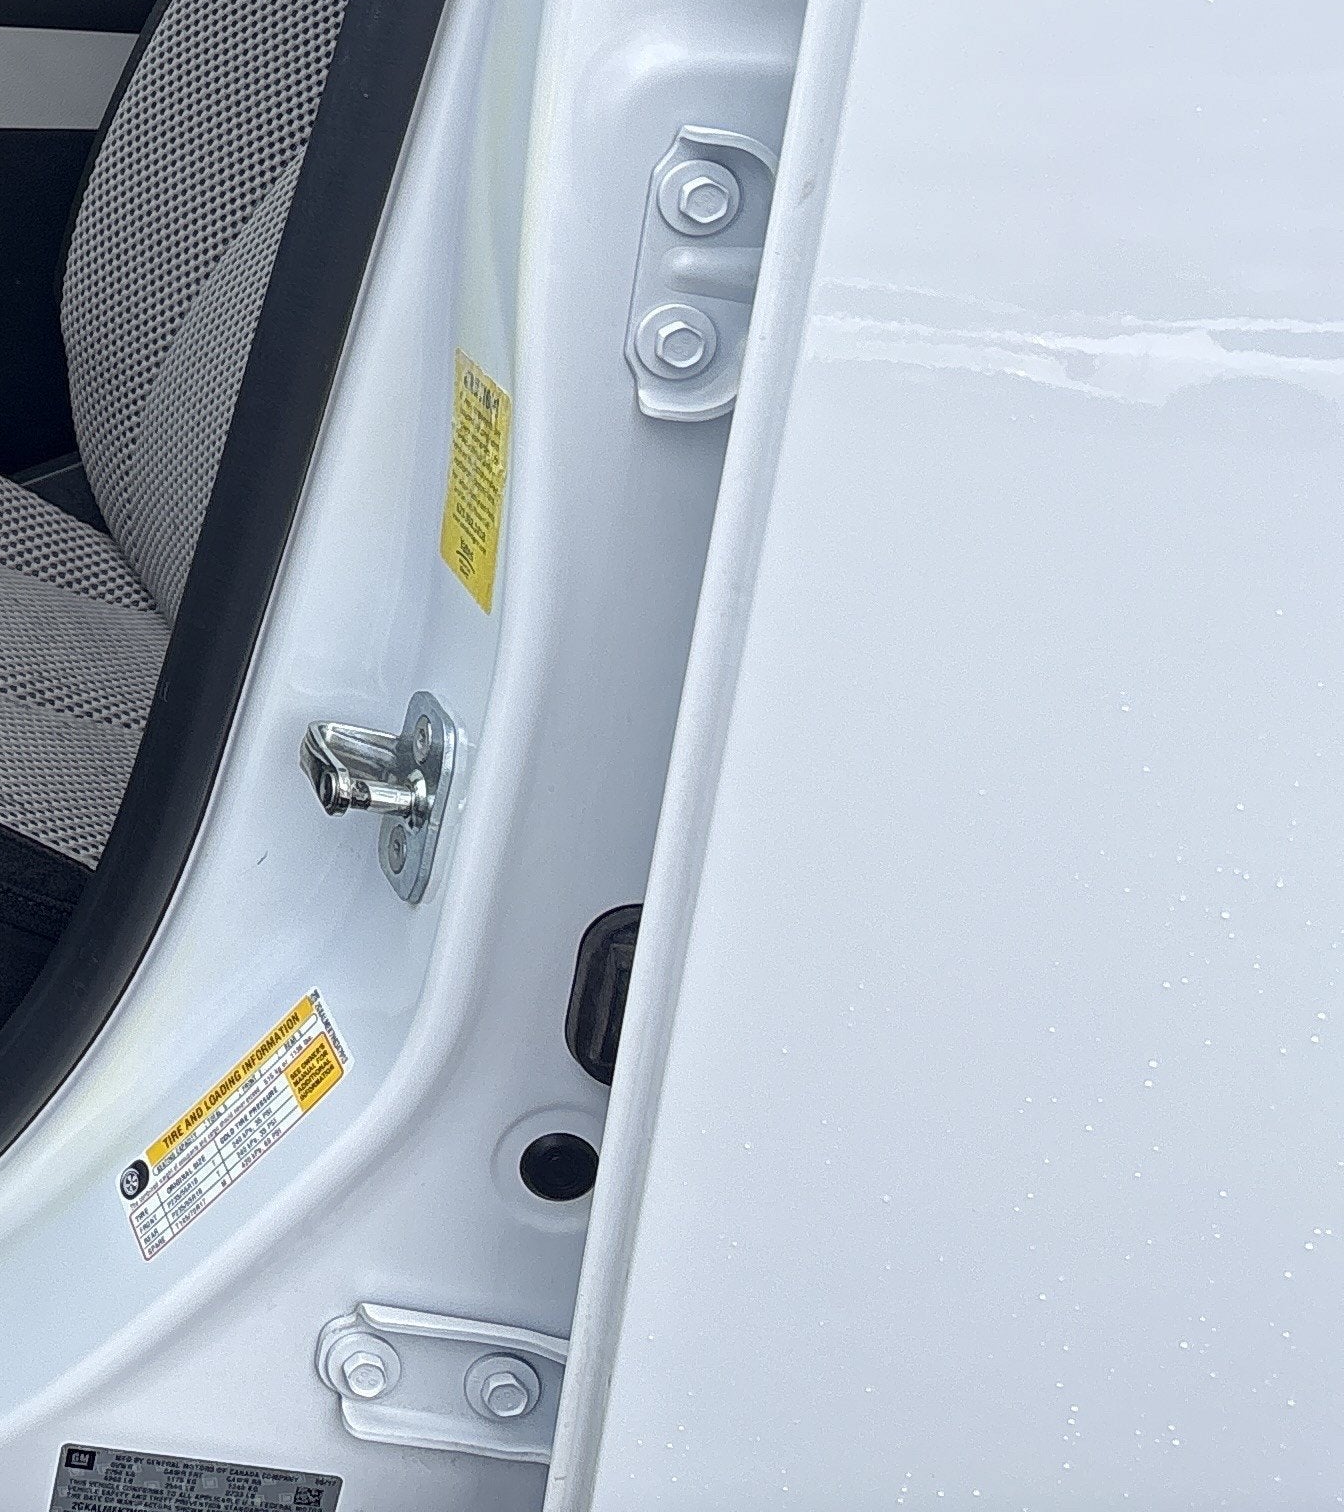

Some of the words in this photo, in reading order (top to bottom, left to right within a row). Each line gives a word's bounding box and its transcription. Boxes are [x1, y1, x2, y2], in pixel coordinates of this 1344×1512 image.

[161, 1123, 184, 1151] TIRE
[182, 1103, 204, 1131] AND
[202, 1067, 242, 1112] LOADING
[239, 1010, 301, 1075] INFORMATION
[288, 1065, 302, 1081] SEE
[291, 1061, 316, 1088] MANUAL
[314, 1048, 329, 1064] FOR
[295, 1056, 332, 1095] ADDITIONAL
[298, 1062, 336, 1102] INFORMATION
